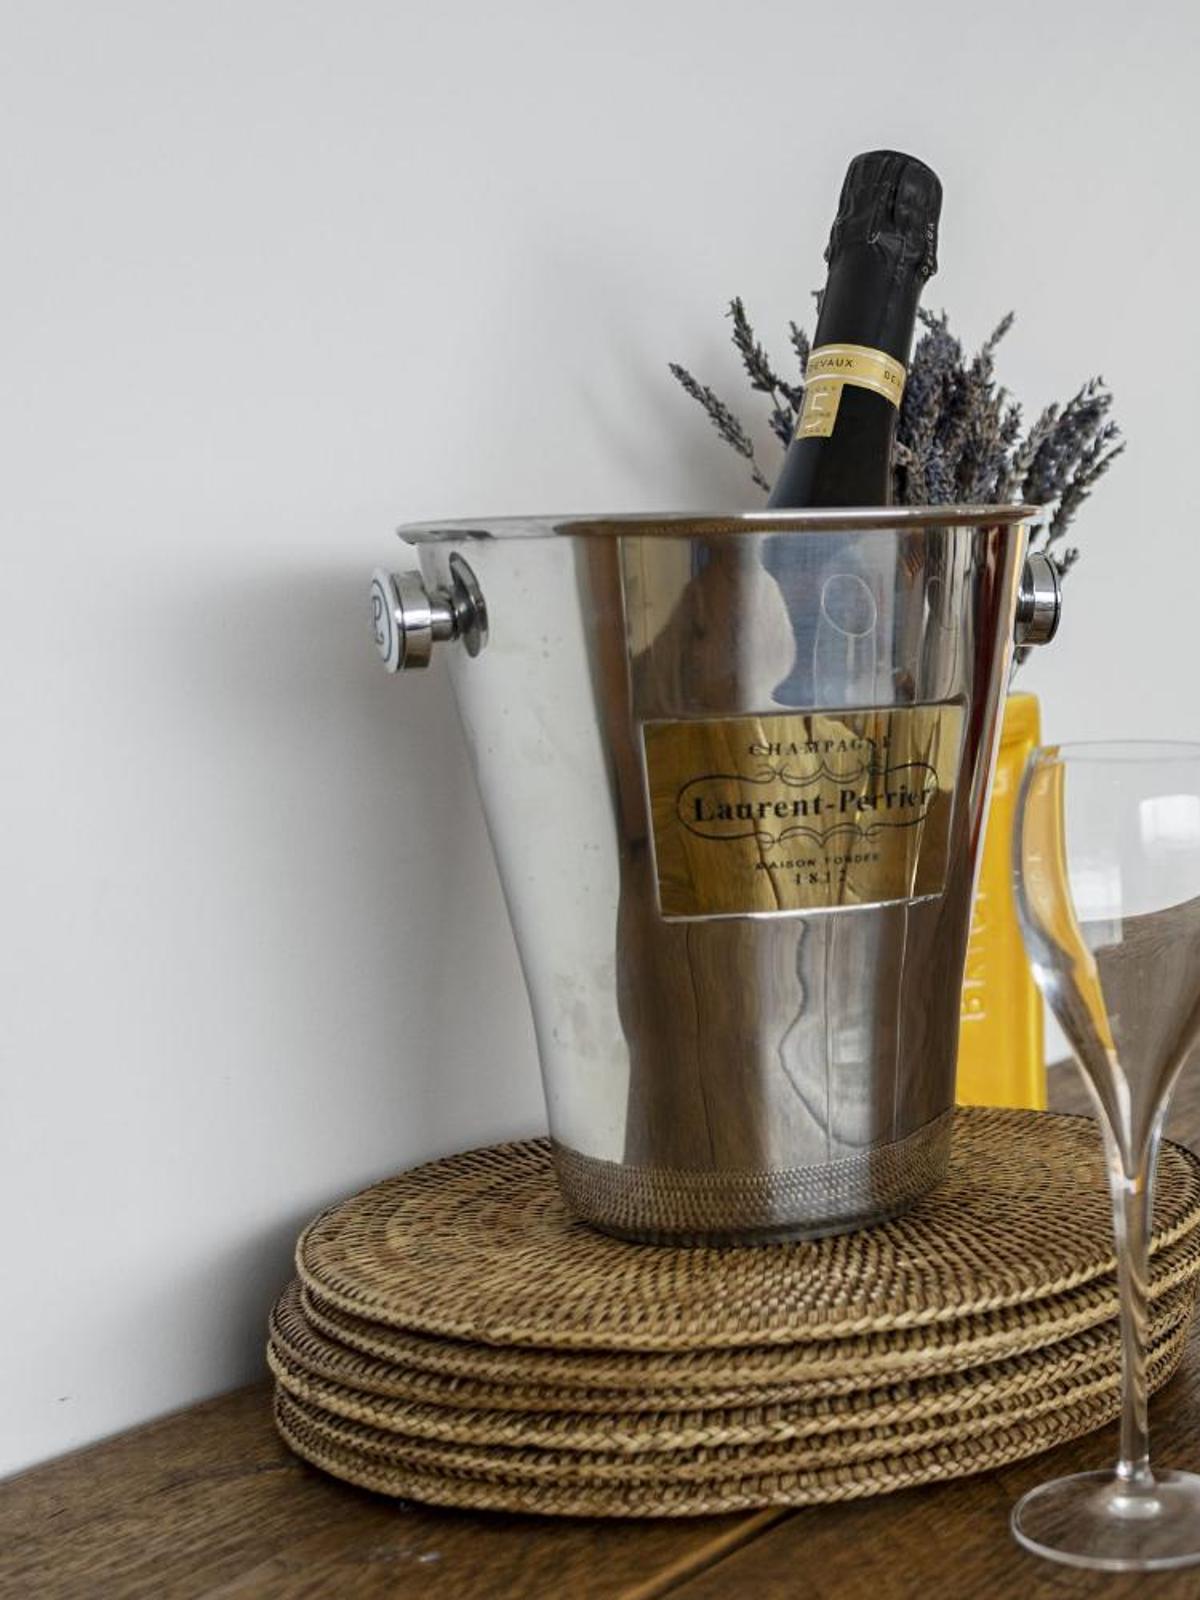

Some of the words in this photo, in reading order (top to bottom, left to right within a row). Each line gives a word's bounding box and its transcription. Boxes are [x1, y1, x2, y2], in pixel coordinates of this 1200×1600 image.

[748, 736, 891, 756] CHAMPAGNE
[692, 785, 932, 822] Laurent-Perrier
[755, 859, 817, 871] MAISON
